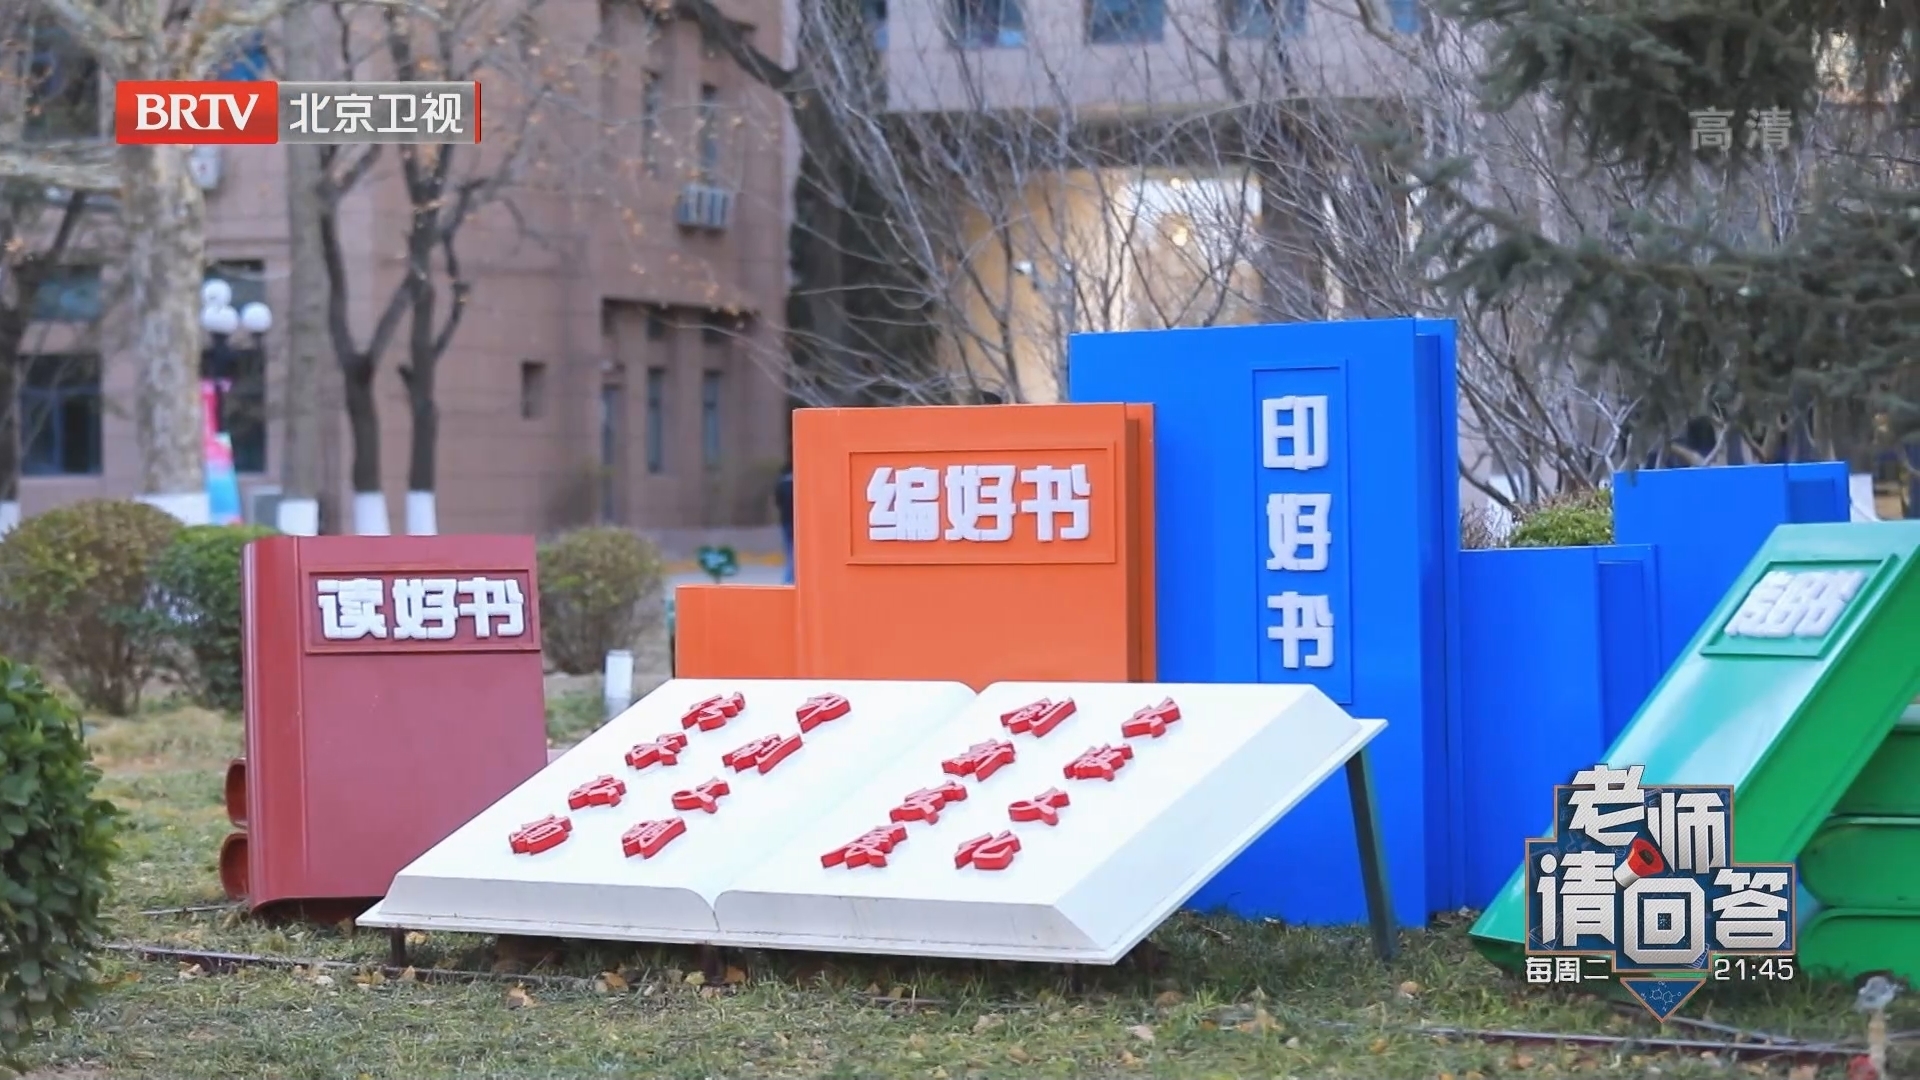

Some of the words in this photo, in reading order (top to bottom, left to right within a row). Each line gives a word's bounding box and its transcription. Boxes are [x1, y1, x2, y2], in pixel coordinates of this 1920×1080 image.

[866, 463, 1092, 542] 编好书
[1261, 394, 1335, 669] 印好书
[316, 576, 525, 640] 读好书
